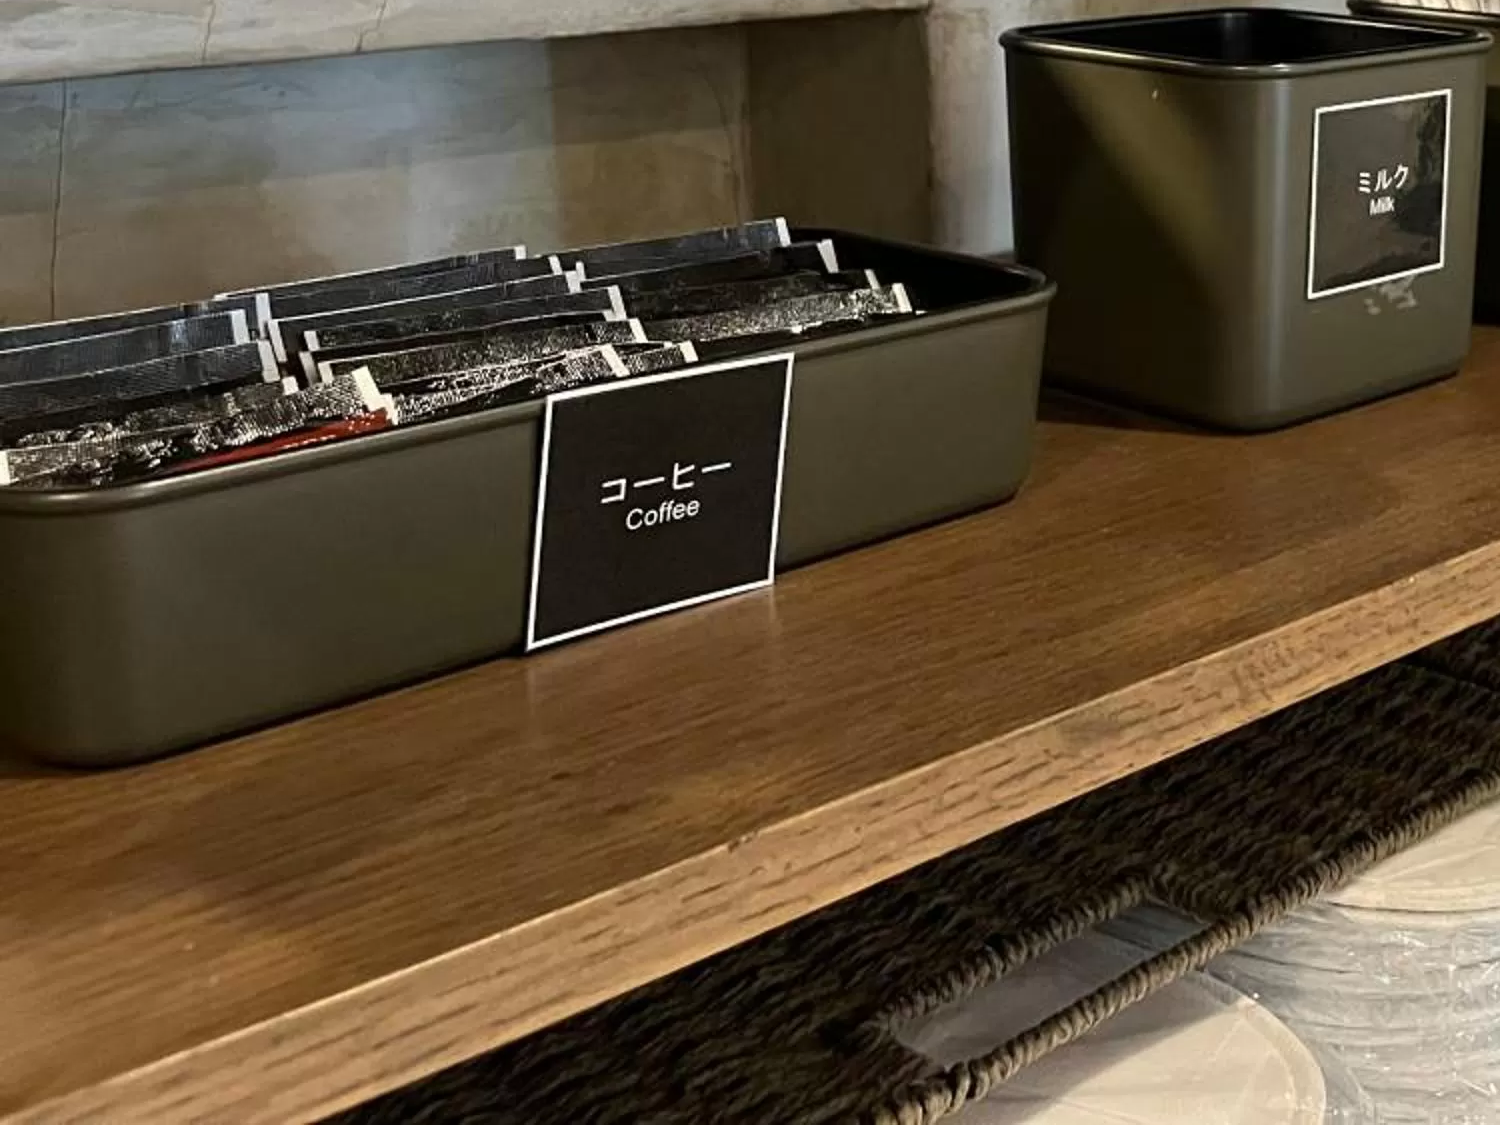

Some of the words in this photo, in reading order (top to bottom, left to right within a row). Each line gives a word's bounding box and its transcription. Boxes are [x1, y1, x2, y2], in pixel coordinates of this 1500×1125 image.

[1358, 164, 1409, 193] ミルク
[600, 462, 732, 504] コーヒー
[625, 499, 700, 531] Coffee
